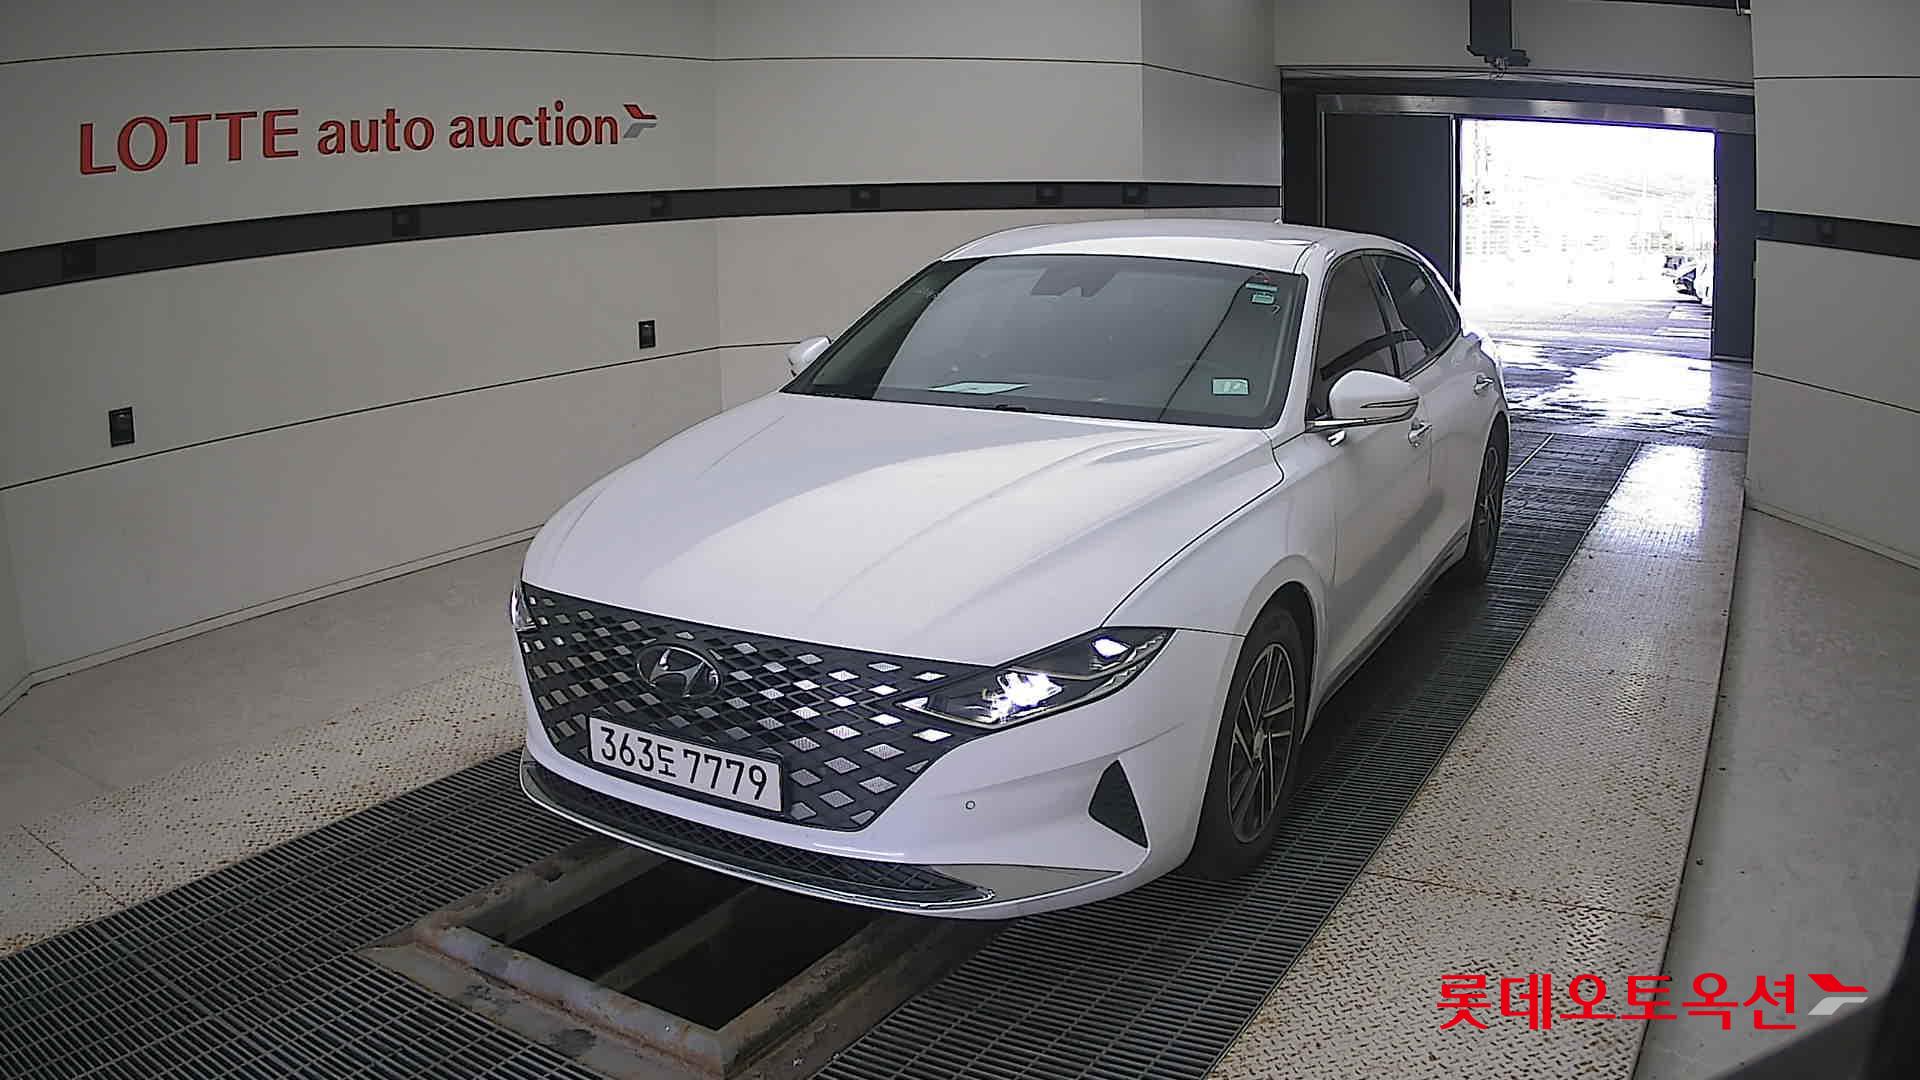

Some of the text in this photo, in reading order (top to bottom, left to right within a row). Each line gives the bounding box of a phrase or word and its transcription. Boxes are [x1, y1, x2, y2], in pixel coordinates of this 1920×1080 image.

[79, 99, 619, 175] LOTTE auto auction
[600, 726, 768, 801] 363도 7779
